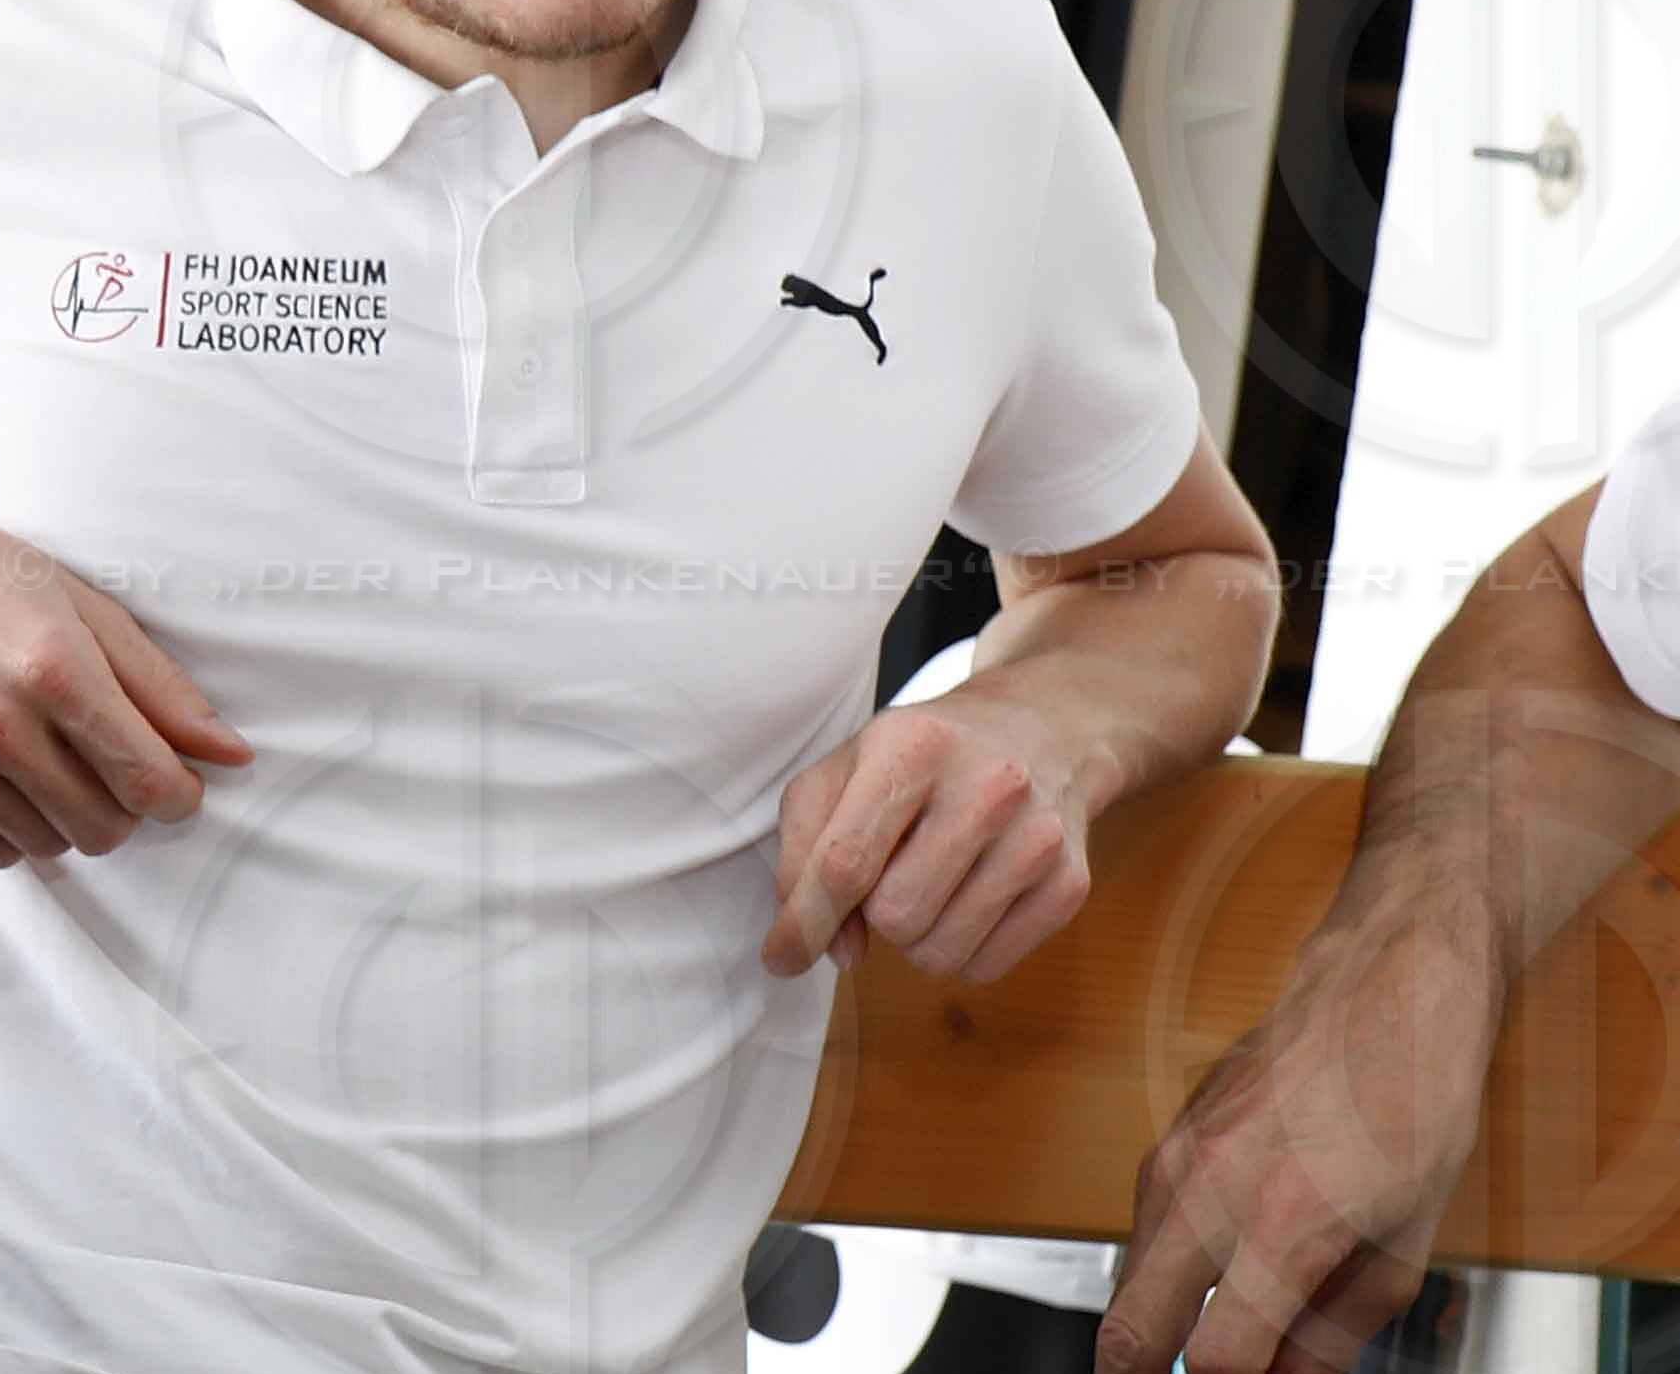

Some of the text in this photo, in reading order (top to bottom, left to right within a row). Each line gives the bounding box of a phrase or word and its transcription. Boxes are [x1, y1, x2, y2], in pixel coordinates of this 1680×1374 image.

[184, 254, 388, 287] FH JOANNEUM
[180, 290, 388, 320] SPORT SCIENCE
[177, 321, 387, 356] LABORATORY
